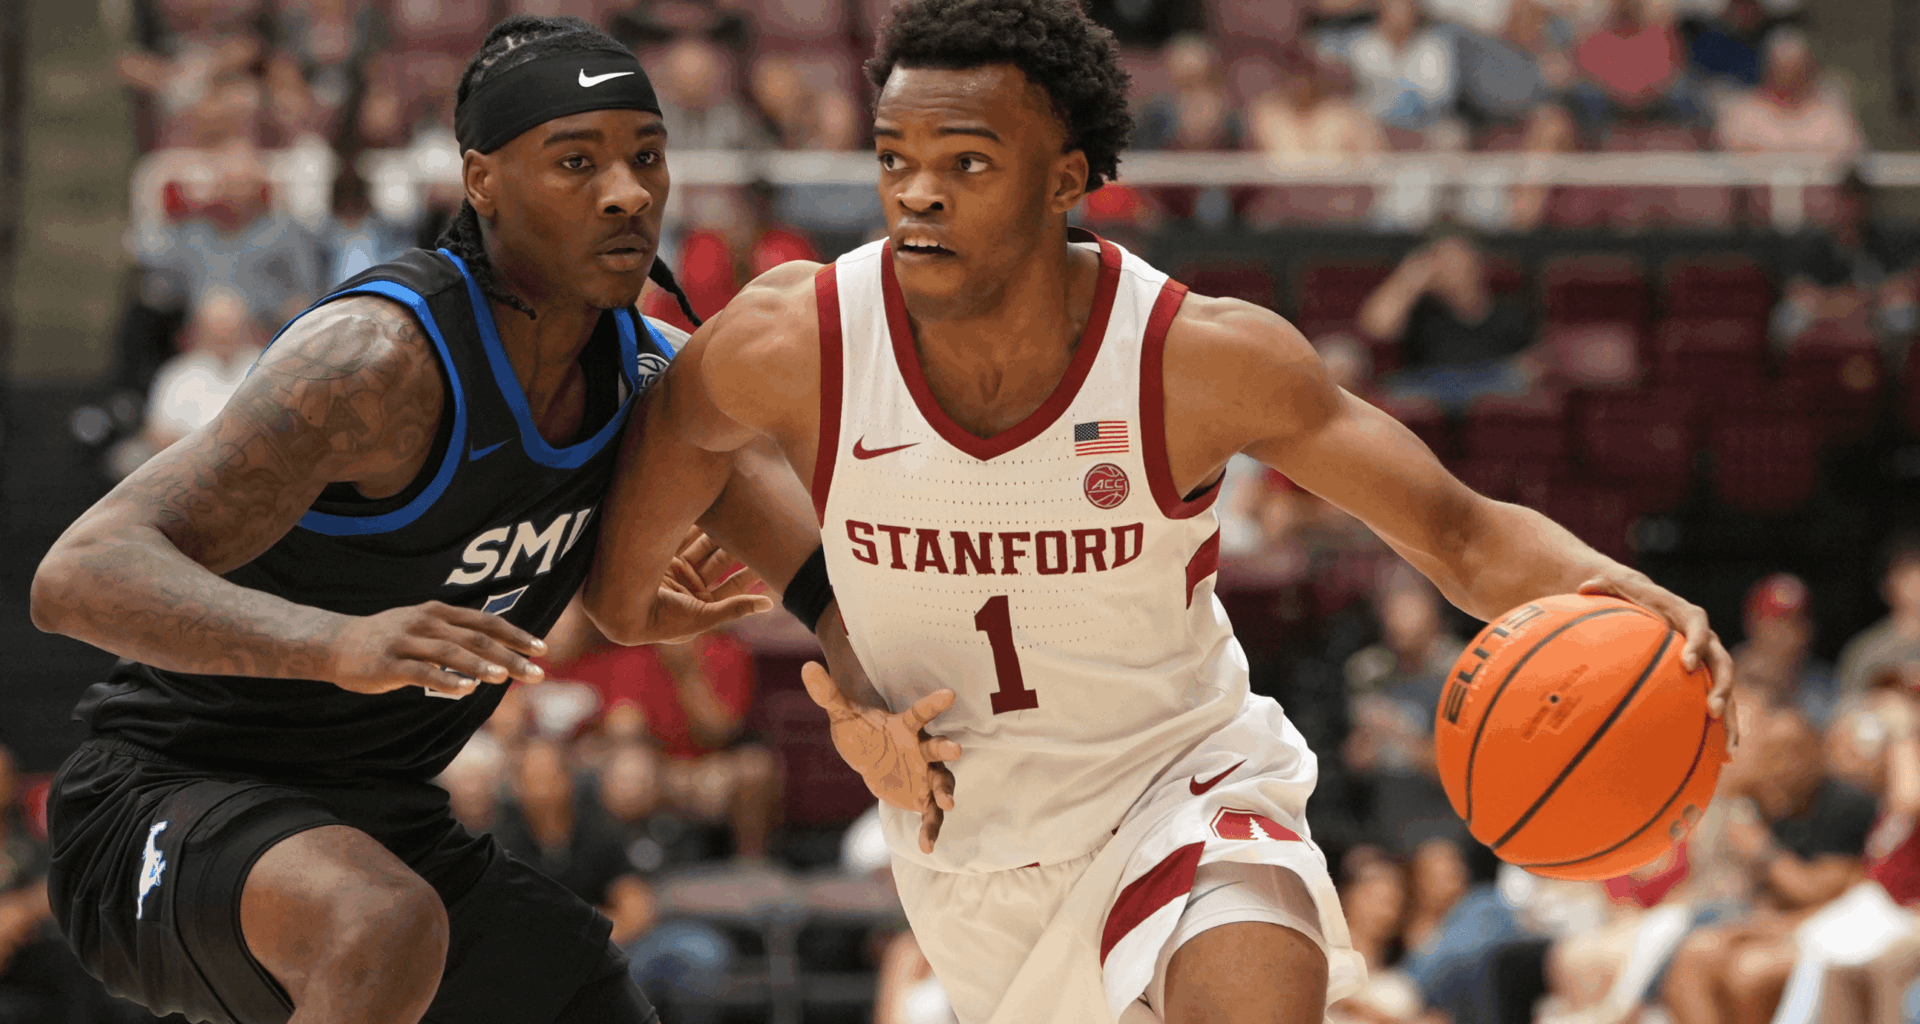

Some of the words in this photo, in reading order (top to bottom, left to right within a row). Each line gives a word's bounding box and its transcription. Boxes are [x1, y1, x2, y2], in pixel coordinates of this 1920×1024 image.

[1091, 478, 1125, 490] ACC
[845, 519, 1144, 575] STANFORD
[974, 595, 1039, 715] 1
[1443, 604, 1546, 725] ELITE
